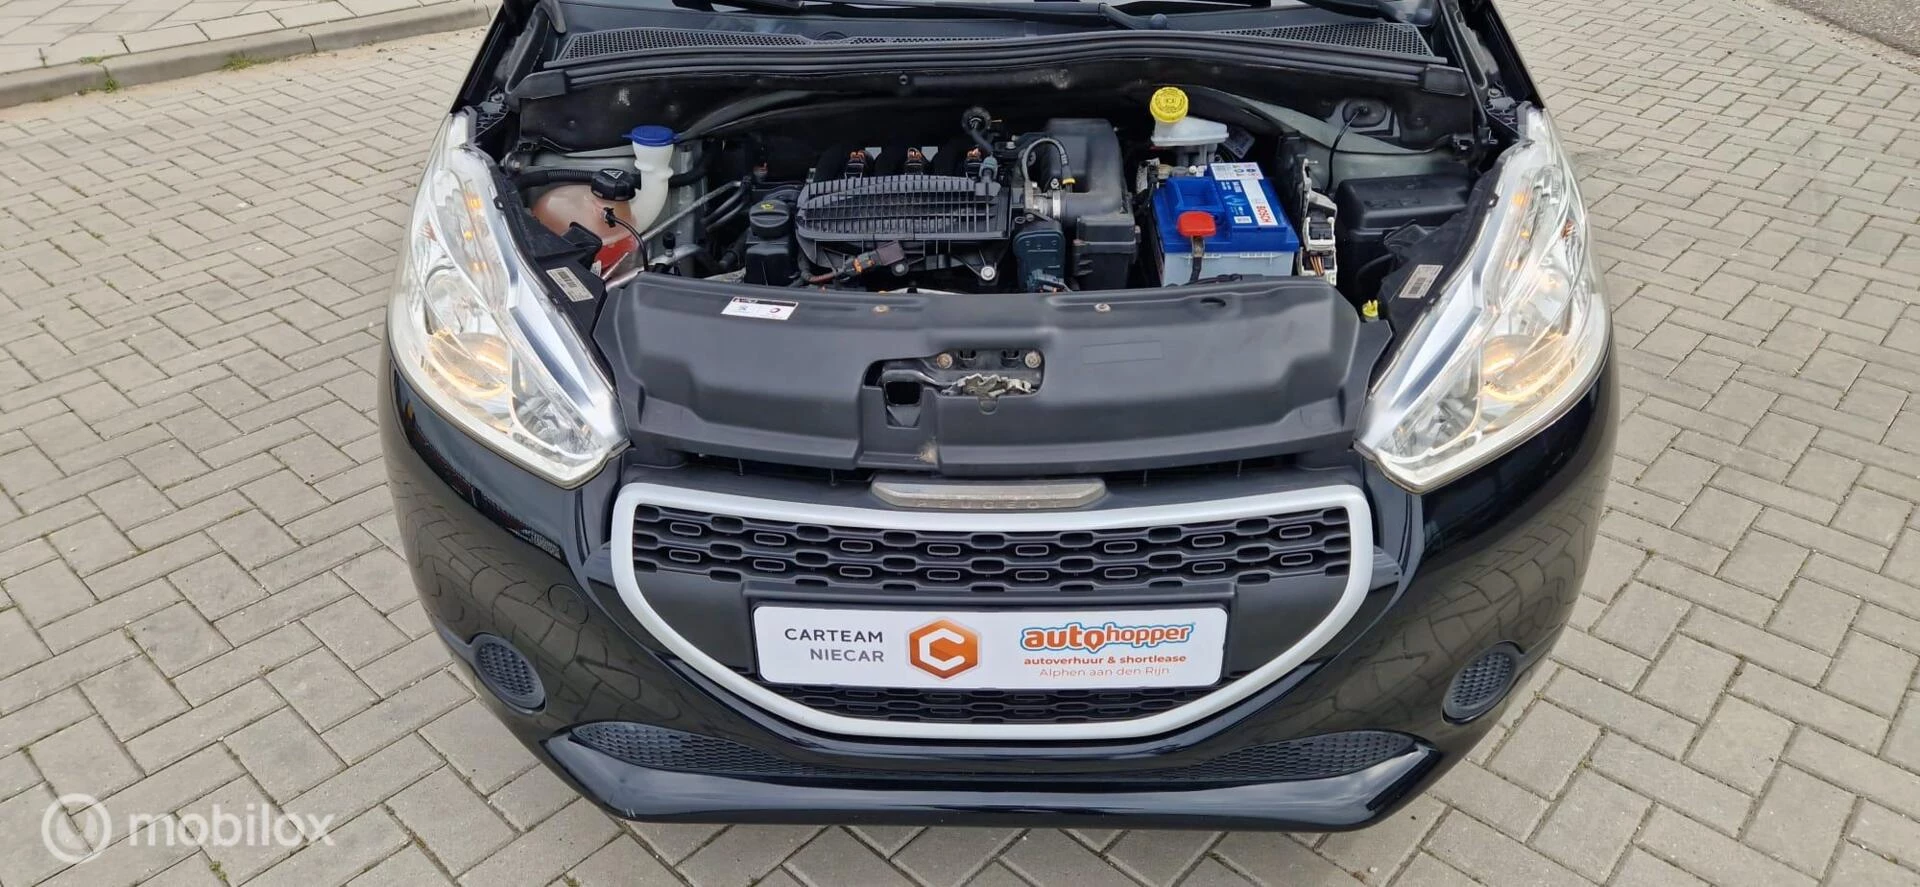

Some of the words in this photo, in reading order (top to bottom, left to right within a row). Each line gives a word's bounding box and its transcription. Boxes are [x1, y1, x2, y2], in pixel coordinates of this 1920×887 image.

[784, 628, 883, 643] CARTEAM
[1022, 623, 1192, 652] autohopper
[810, 648, 885, 662] NIECAR
[1023, 656, 1105, 665] autoverhuur
[1107, 656, 1116, 664] &
[1119, 655, 1187, 664] shortlease
[1039, 668, 1086, 679] Alphen
[1089, 669, 1113, 677] aan
[1116, 667, 1141, 676] den
[1145, 666, 1170, 677] Rijn
